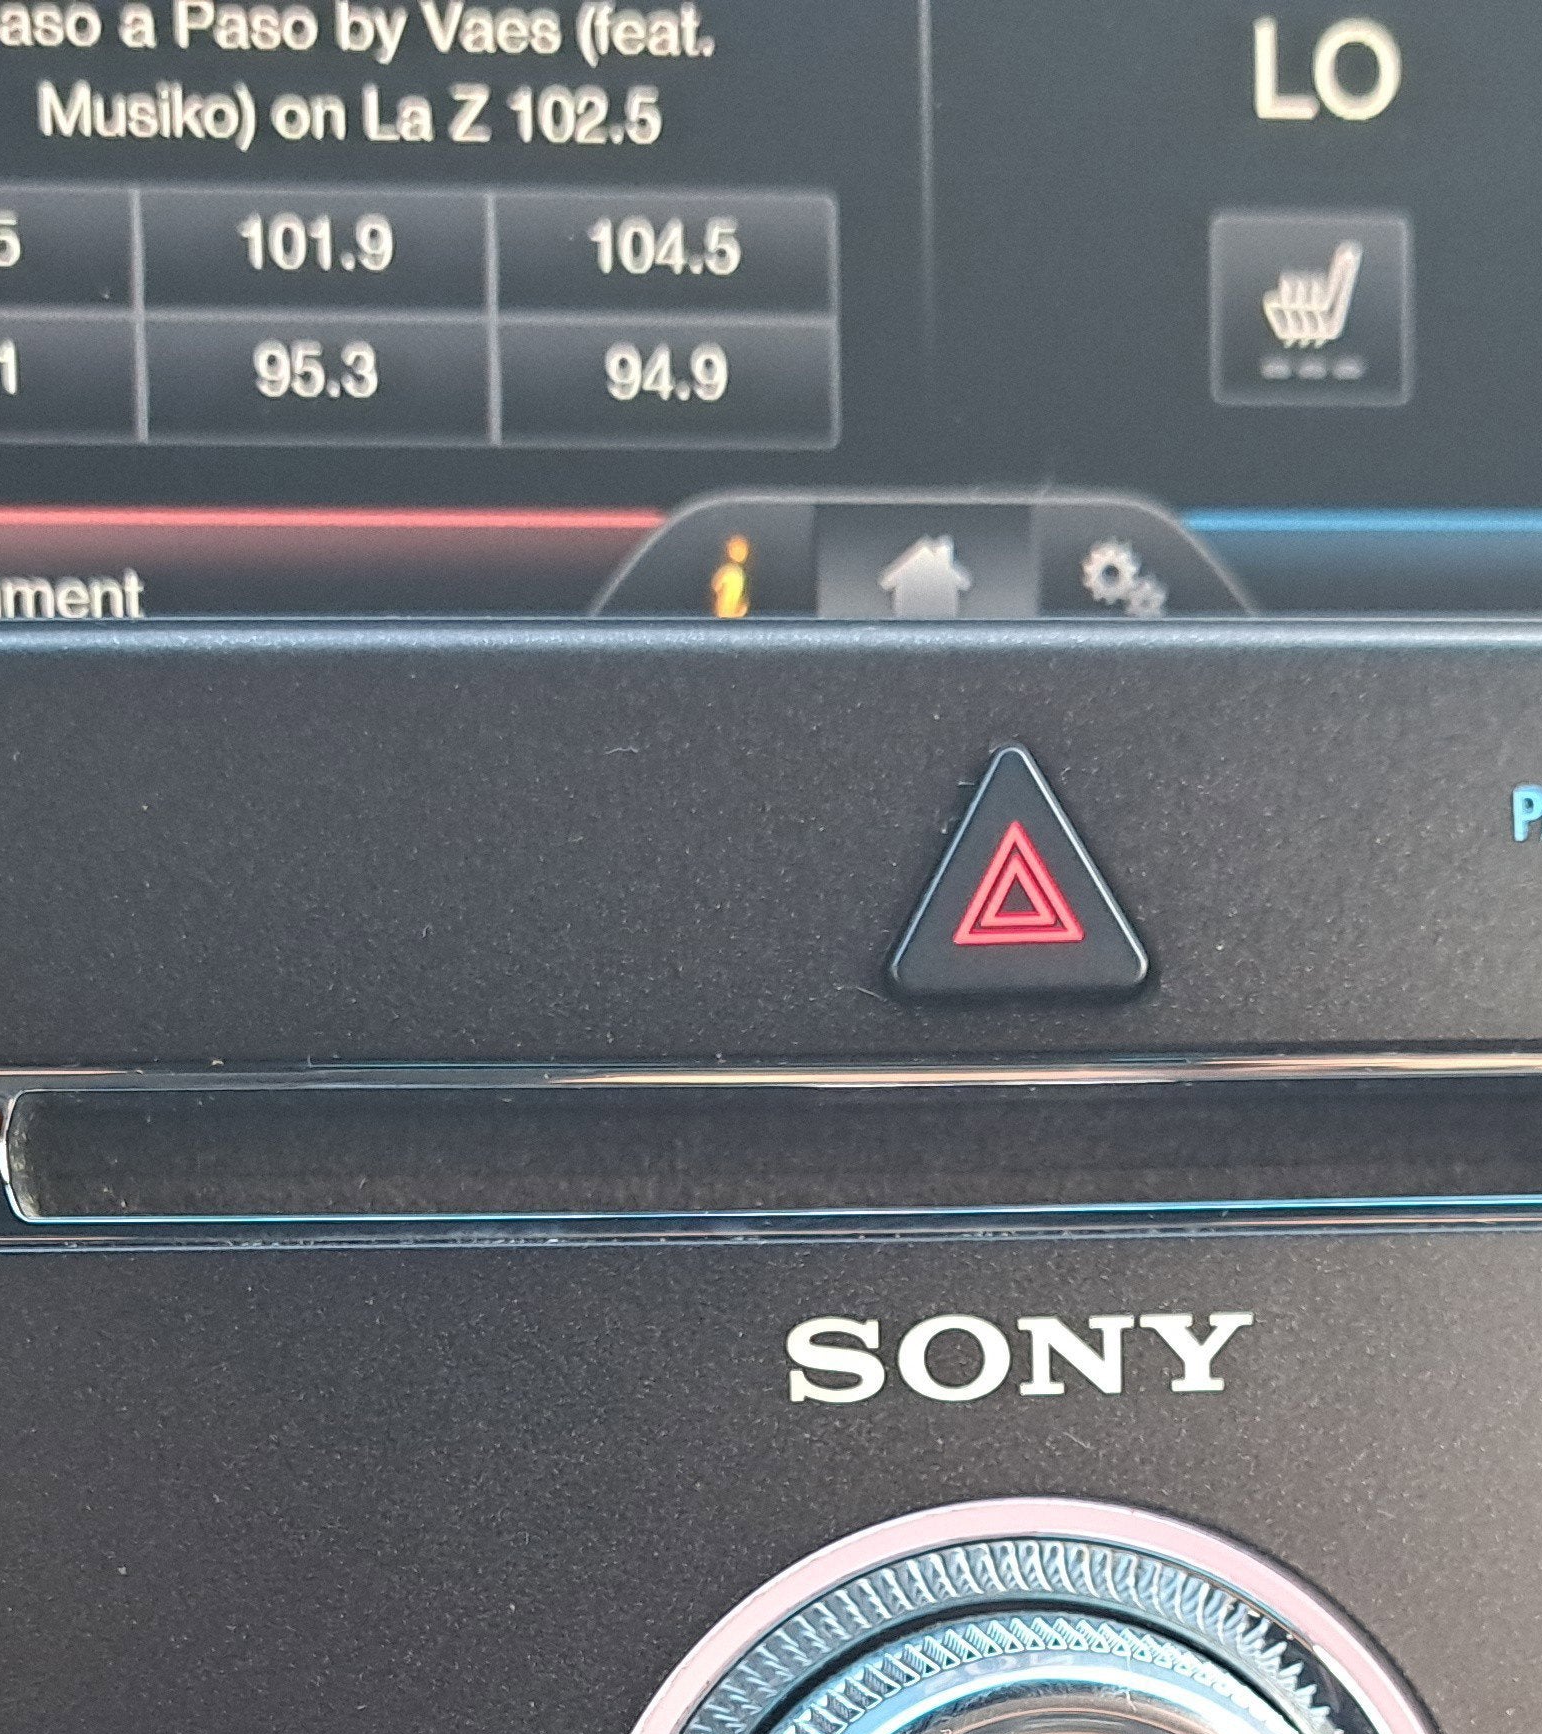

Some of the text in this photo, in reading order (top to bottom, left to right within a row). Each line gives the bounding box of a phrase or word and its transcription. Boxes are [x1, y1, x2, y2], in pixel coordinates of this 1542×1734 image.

[118, 5, 156, 50] a
[173, 0, 320, 52] Paso
[335, 0, 408, 65] by
[425, 0, 562, 55] Vaes
[578, 0, 716, 68] (feat.
[1253, 17, 1403, 121] LO
[37, 80, 663, 151] Musiko) on La Z 102.5
[239, 213, 394, 272] 101.9
[589, 217, 742, 277] 104.5
[253, 342, 379, 399] 95.3
[604, 343, 730, 401] 94.9
[785, 1312, 1255, 1403] SONY
